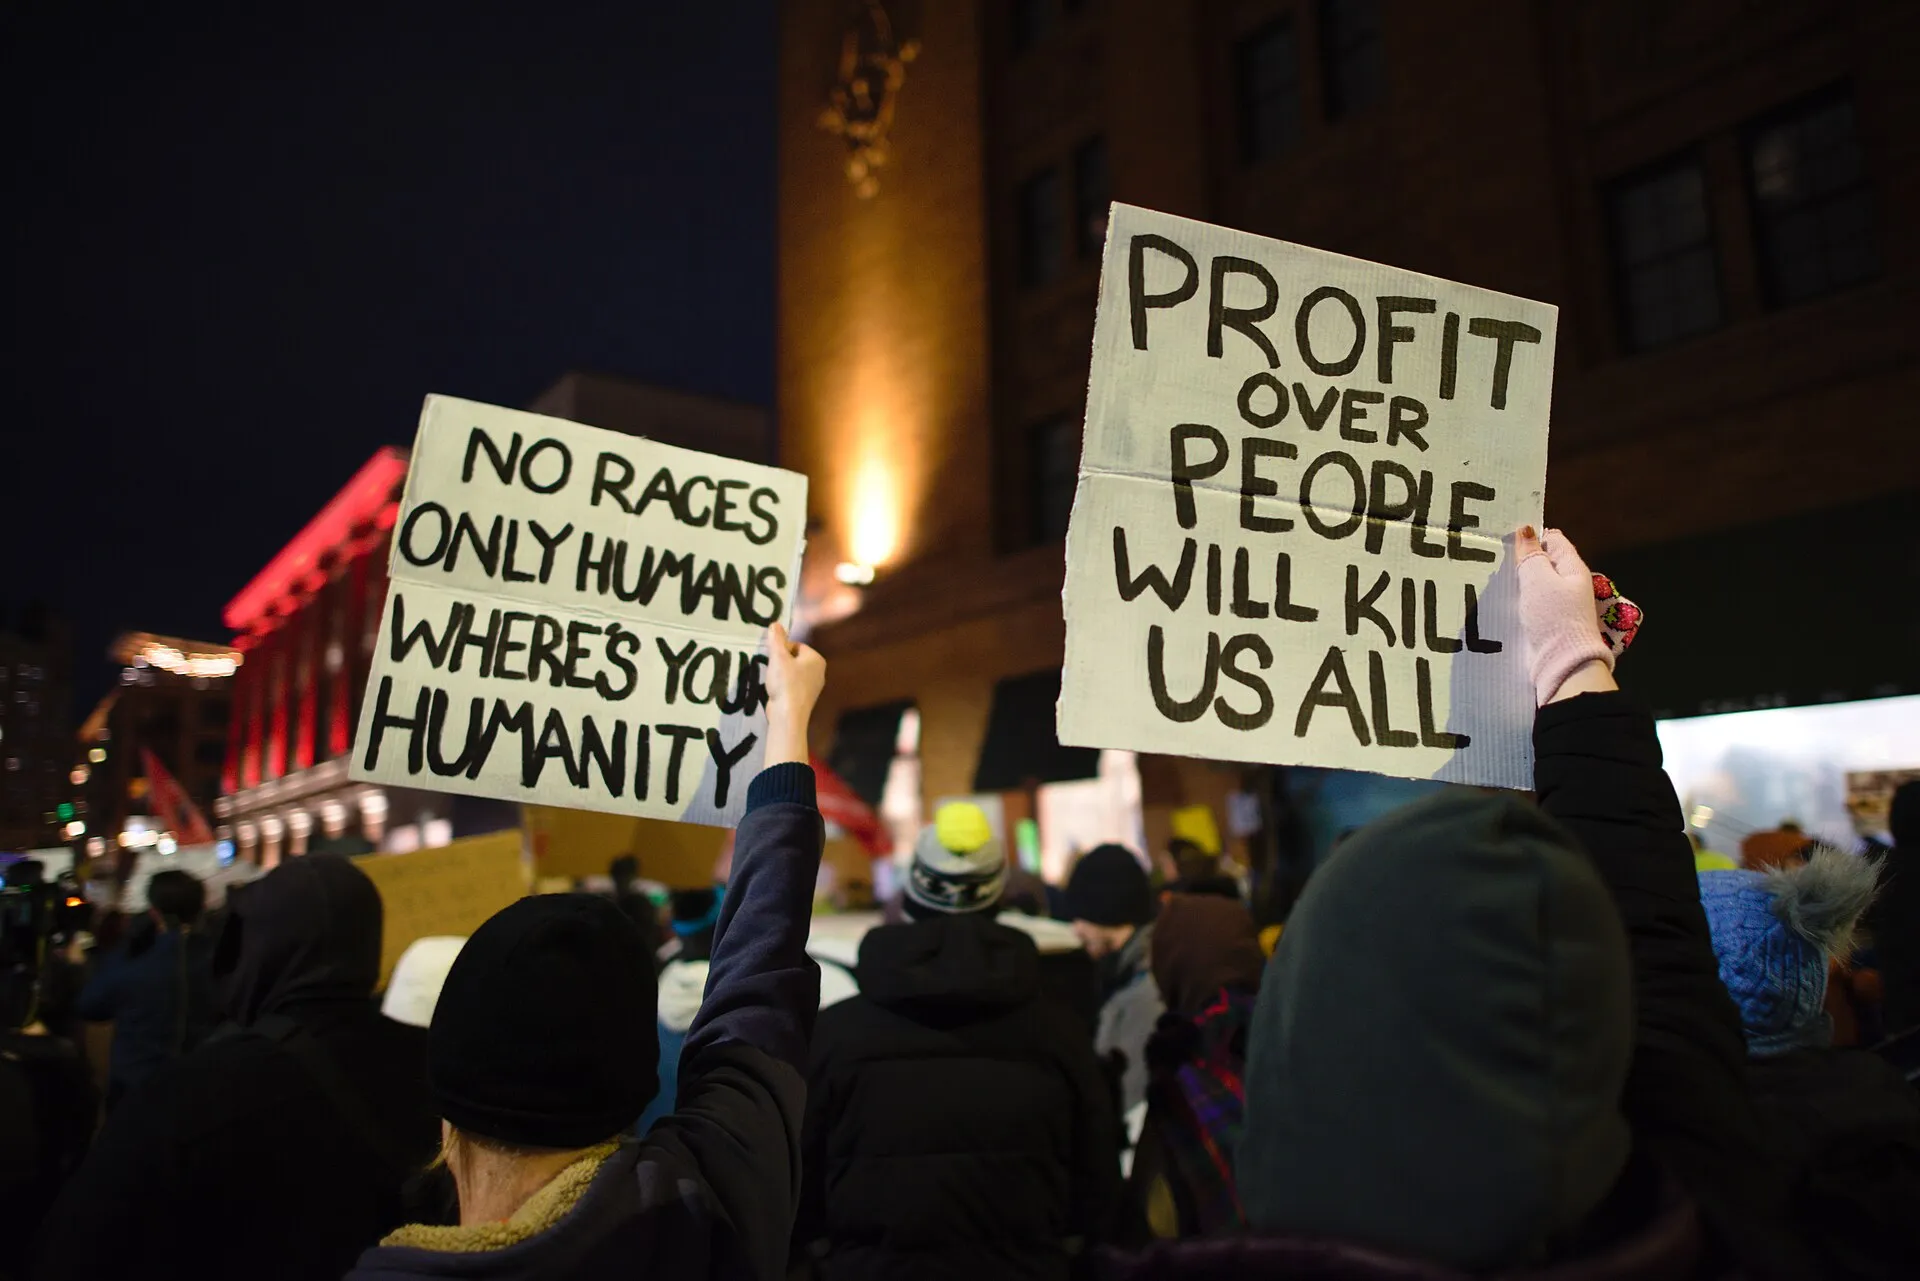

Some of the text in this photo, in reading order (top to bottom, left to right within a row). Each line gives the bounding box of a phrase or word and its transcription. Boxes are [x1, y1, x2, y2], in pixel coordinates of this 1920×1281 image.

[1129, 234, 1541, 410] PROFIT
[1237, 371, 1429, 452] OVER
[462, 428, 780, 546] NO RACES
[1171, 424, 1496, 563] PEOPLE
[399, 502, 786, 628] ONLY HUMANS
[1113, 526, 1502, 653] WILL KILL
[391, 594, 640, 700] WHERE'S
[1148, 625, 1470, 748] US ALL
[364, 676, 758, 808] HUMANITY
